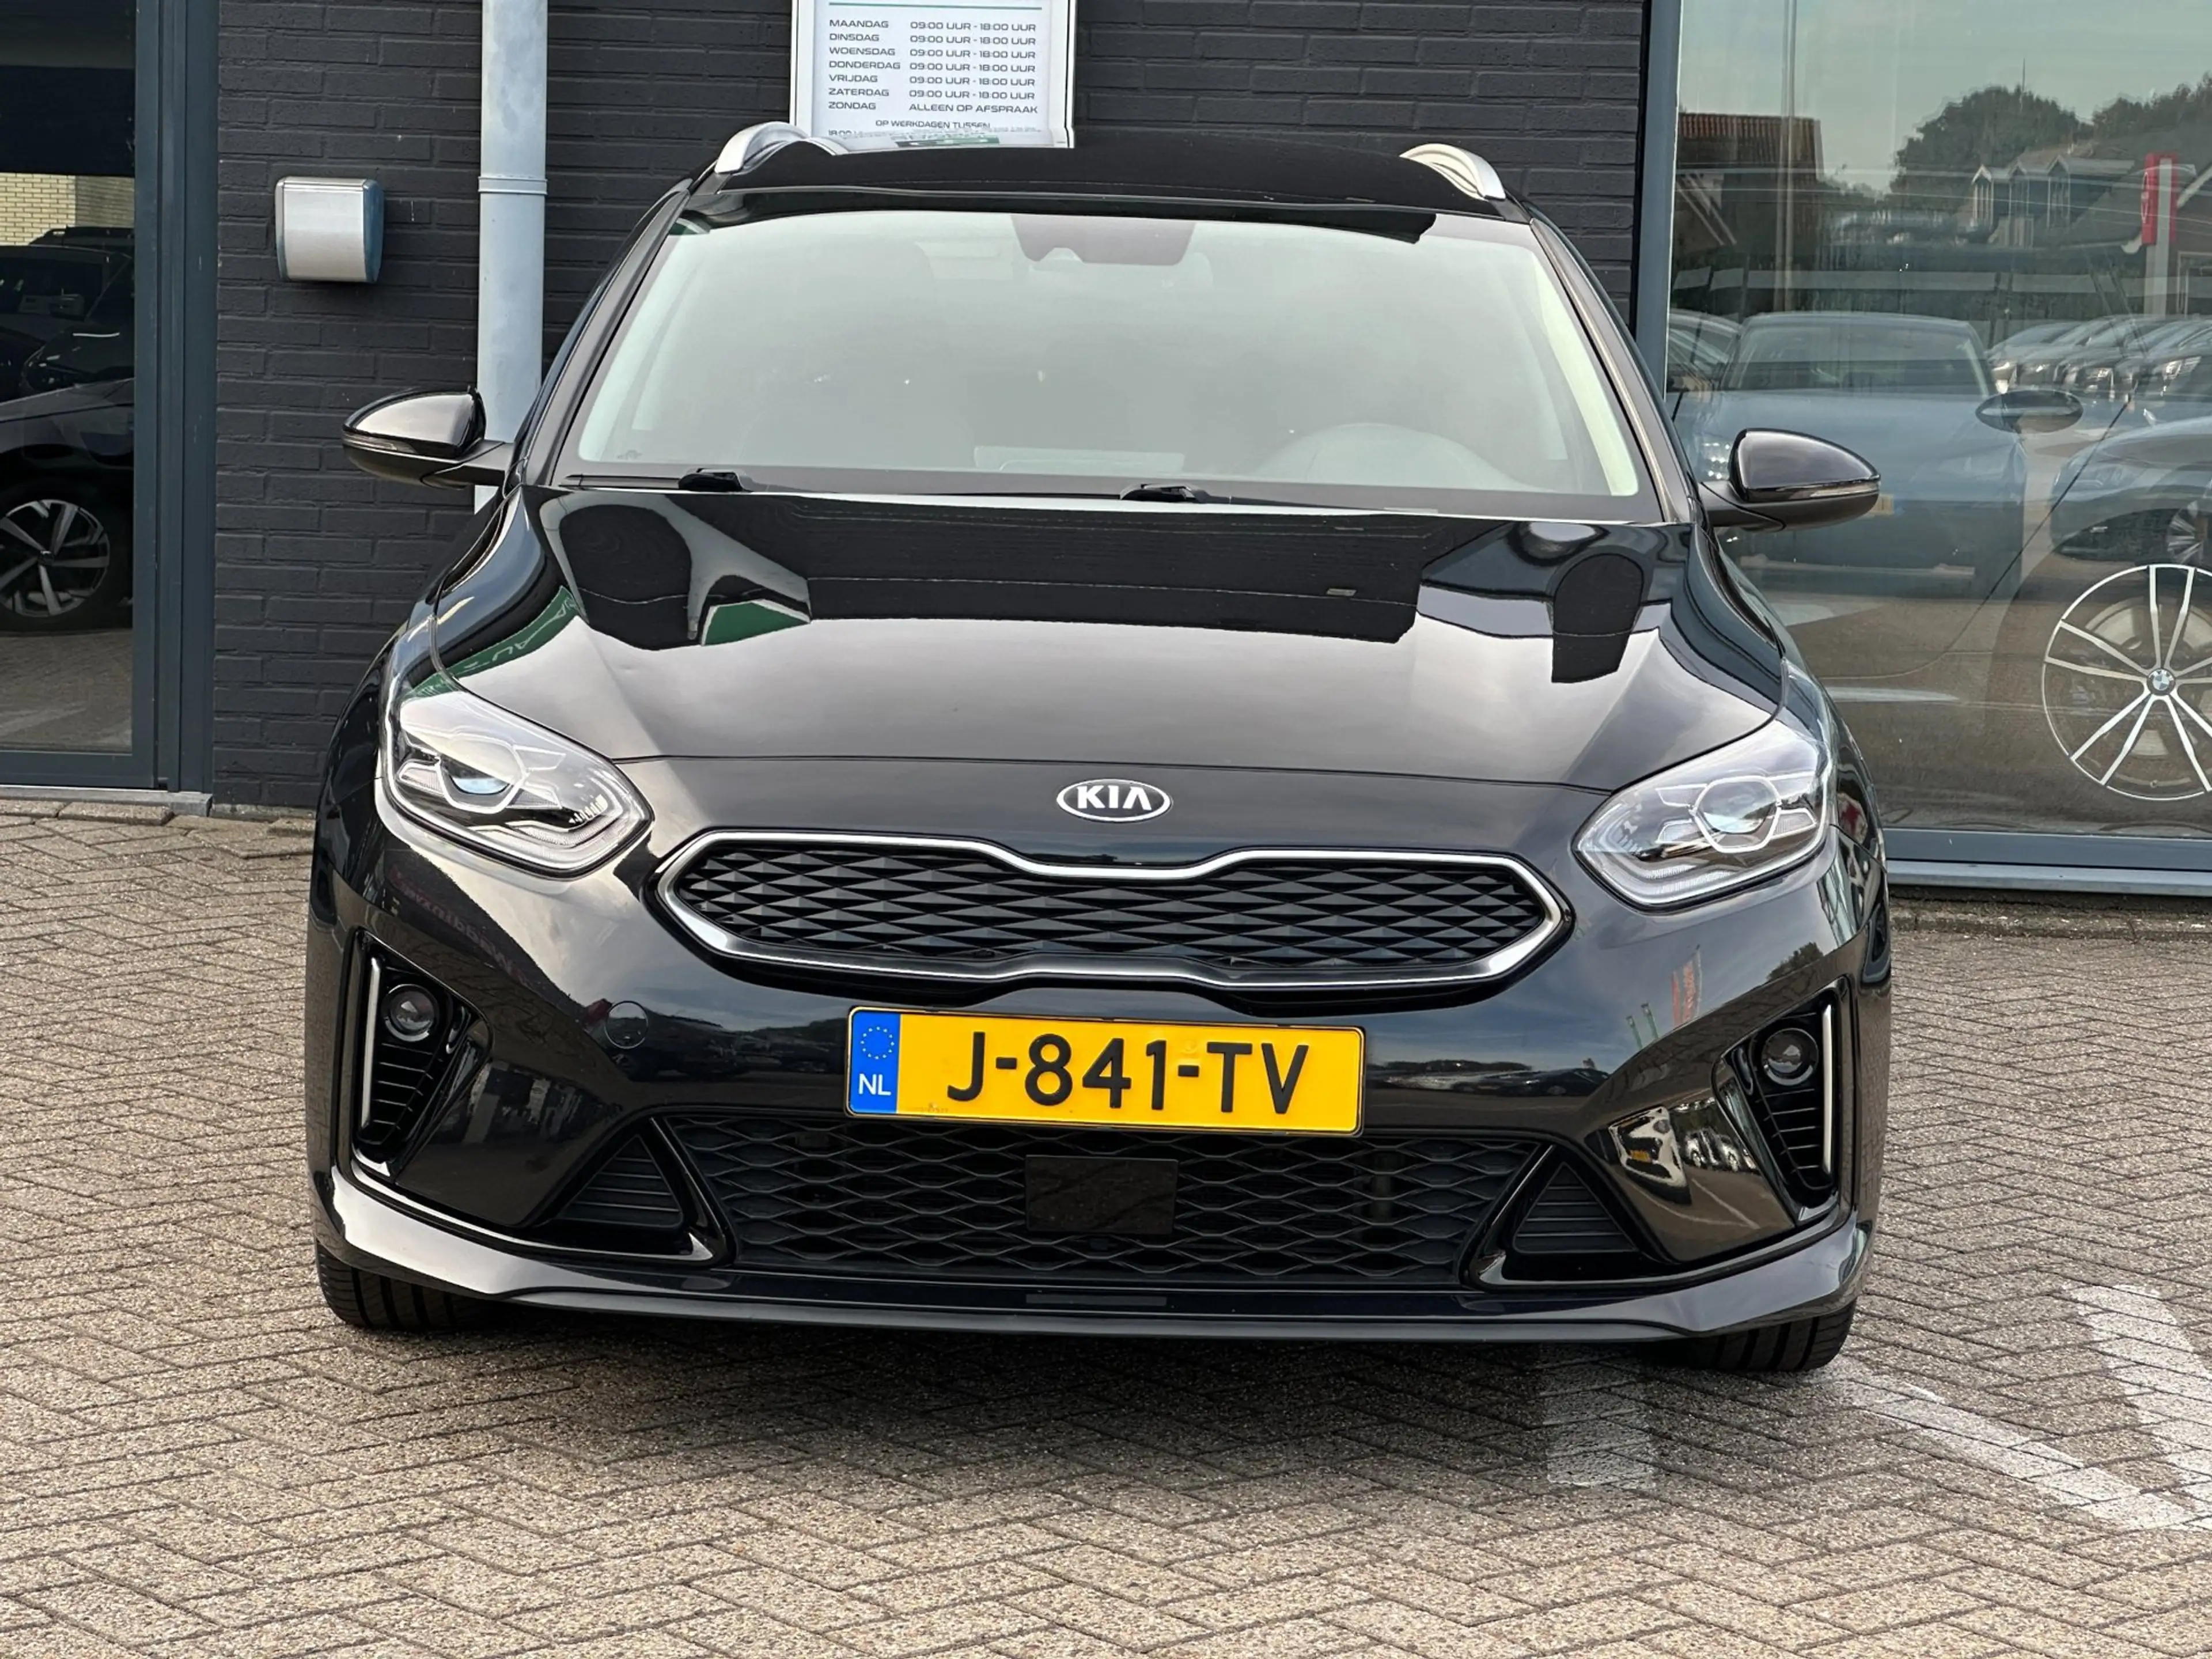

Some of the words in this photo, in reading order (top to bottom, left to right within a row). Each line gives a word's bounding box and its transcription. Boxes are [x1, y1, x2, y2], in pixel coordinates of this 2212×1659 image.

[829, 20, 889, 28] MAANDAG
[829, 33, 880, 41] DINSDAG
[910, 35, 943, 43] 09:00
[1011, 37, 1036, 46] UUR
[829, 47, 895, 56] WOENSDAG
[910, 49, 943, 57] 09:00
[945, 50, 971, 58] UUR
[828, 60, 900, 69] DONDERDAG
[909, 62, 943, 71] 09:00
[979, 64, 1007, 72] 18:00
[1010, 65, 1035, 73] UUR
[828, 74, 878, 82] VRIJDAG
[909, 76, 943, 84] 09:00
[979, 78, 1007, 86] 18:00
[1010, 78, 1035, 86] UUR
[828, 88, 889, 96] ZATERDAG
[908, 90, 942, 98] 09:00
[944, 90, 969, 99] UUR
[828, 101, 876, 110] ZONDAG
[975, 105, 1037, 113] AFSPRAAK
[890, 120, 950, 129] WERKDAGEN
[1077, 785, 1152, 810] KIA
[947, 1031, 1309, 1115] J-841-TV
[859, 1073, 891, 1096] NL
